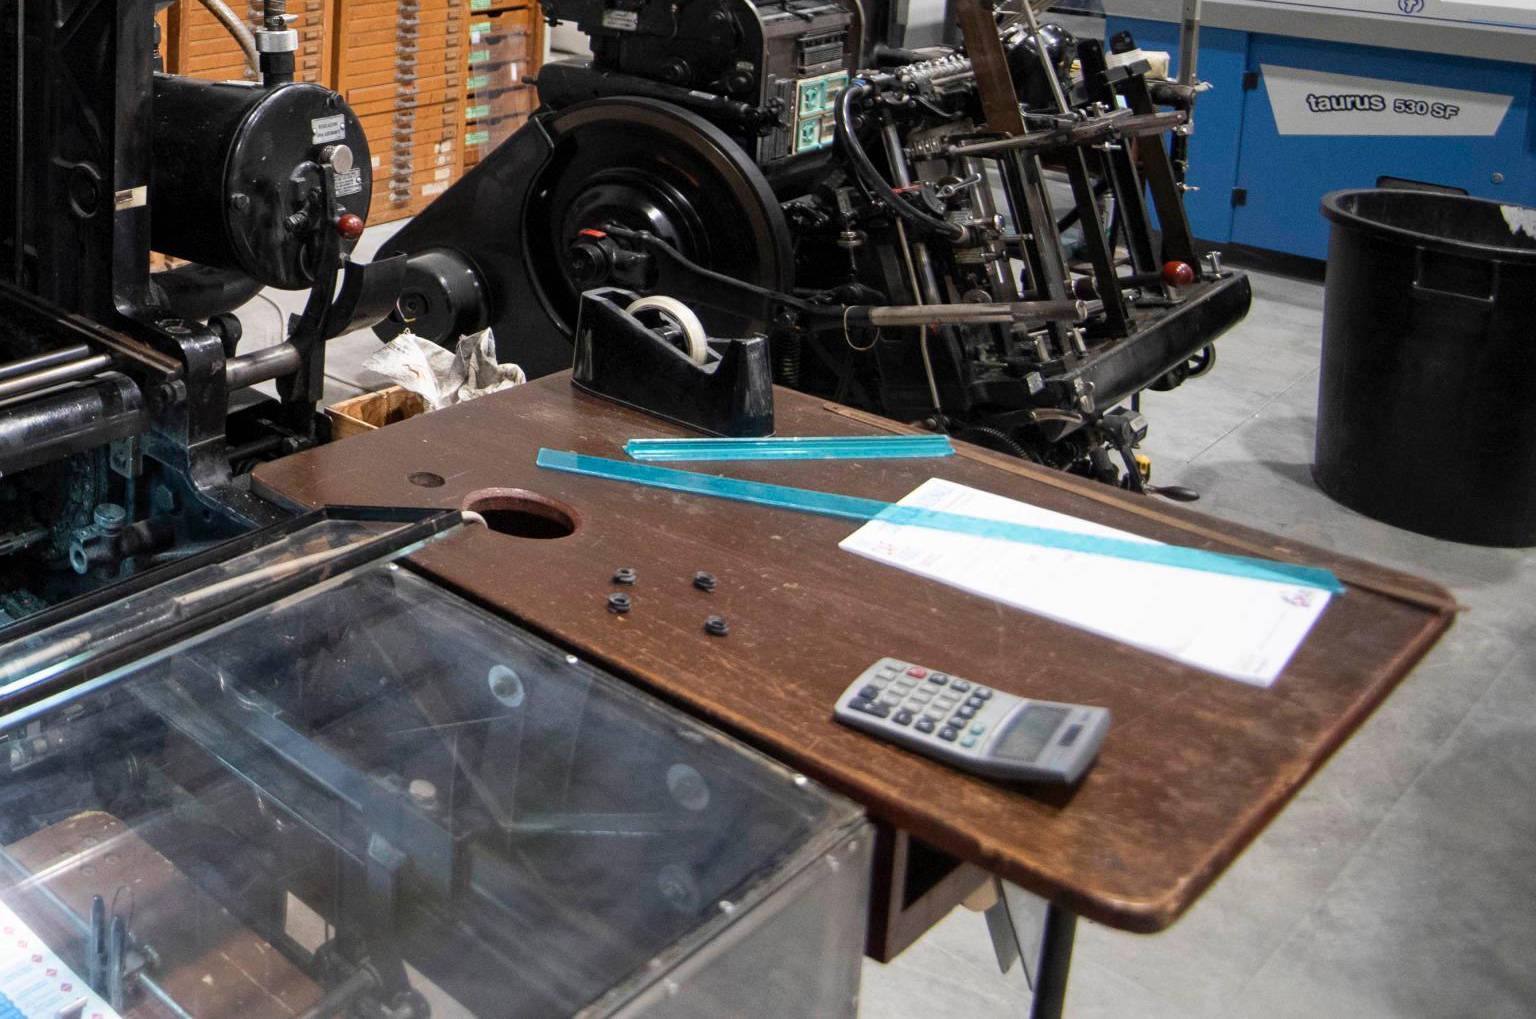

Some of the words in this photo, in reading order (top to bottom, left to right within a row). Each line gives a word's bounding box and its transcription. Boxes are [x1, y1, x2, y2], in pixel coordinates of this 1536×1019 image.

[1306, 93, 1386, 112] taurus
[1393, 98, 1429, 116] 530
[1431, 102, 1460, 120] SF
